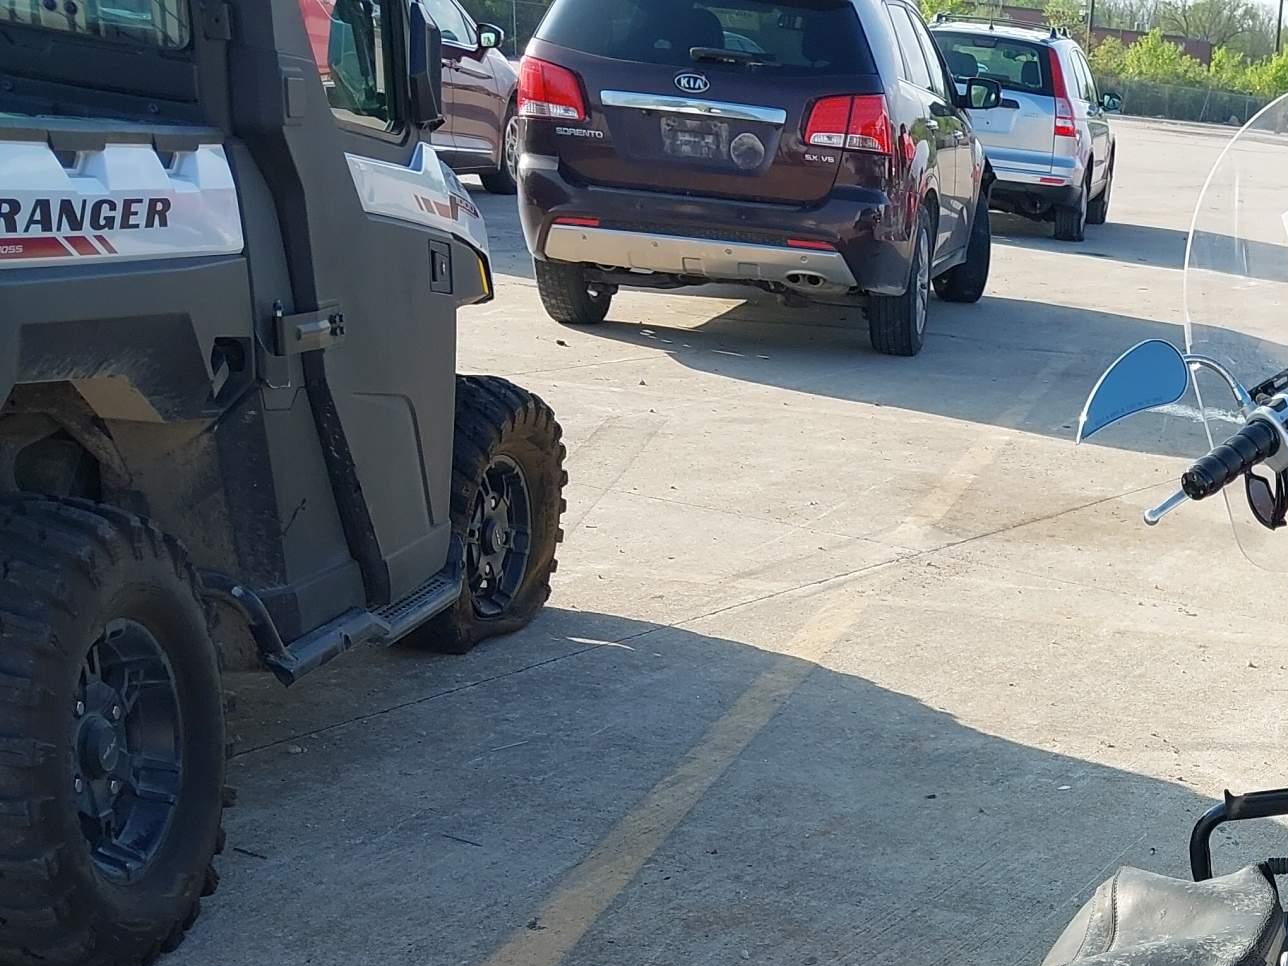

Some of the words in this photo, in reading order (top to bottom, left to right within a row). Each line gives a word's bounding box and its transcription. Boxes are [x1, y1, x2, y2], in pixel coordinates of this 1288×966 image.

[680, 77, 705, 89] KIA
[555, 126, 604, 139] SORENTO
[0, 198, 172, 233] RANGER
